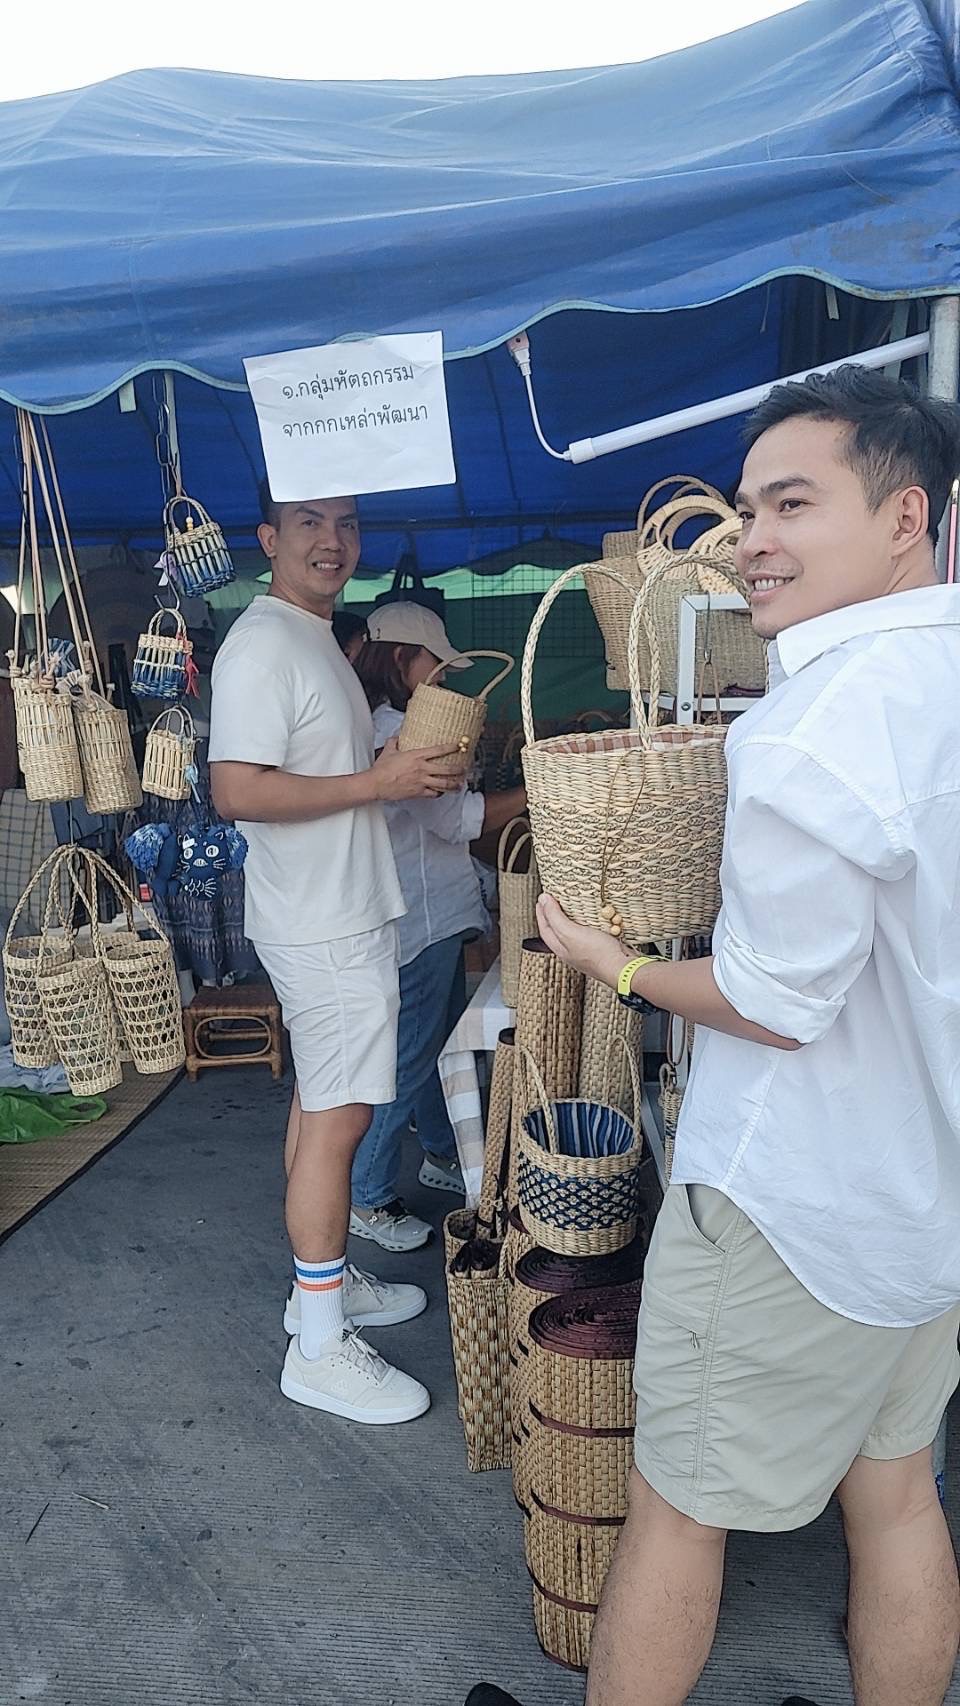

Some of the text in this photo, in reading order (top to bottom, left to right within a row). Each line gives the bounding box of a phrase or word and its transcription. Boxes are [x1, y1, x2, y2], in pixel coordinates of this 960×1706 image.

[282, 365, 414, 400] ๑.กลุ่มหัตถกรรม
[282, 404, 429, 437] จากกกเหล่าพัฒนา
